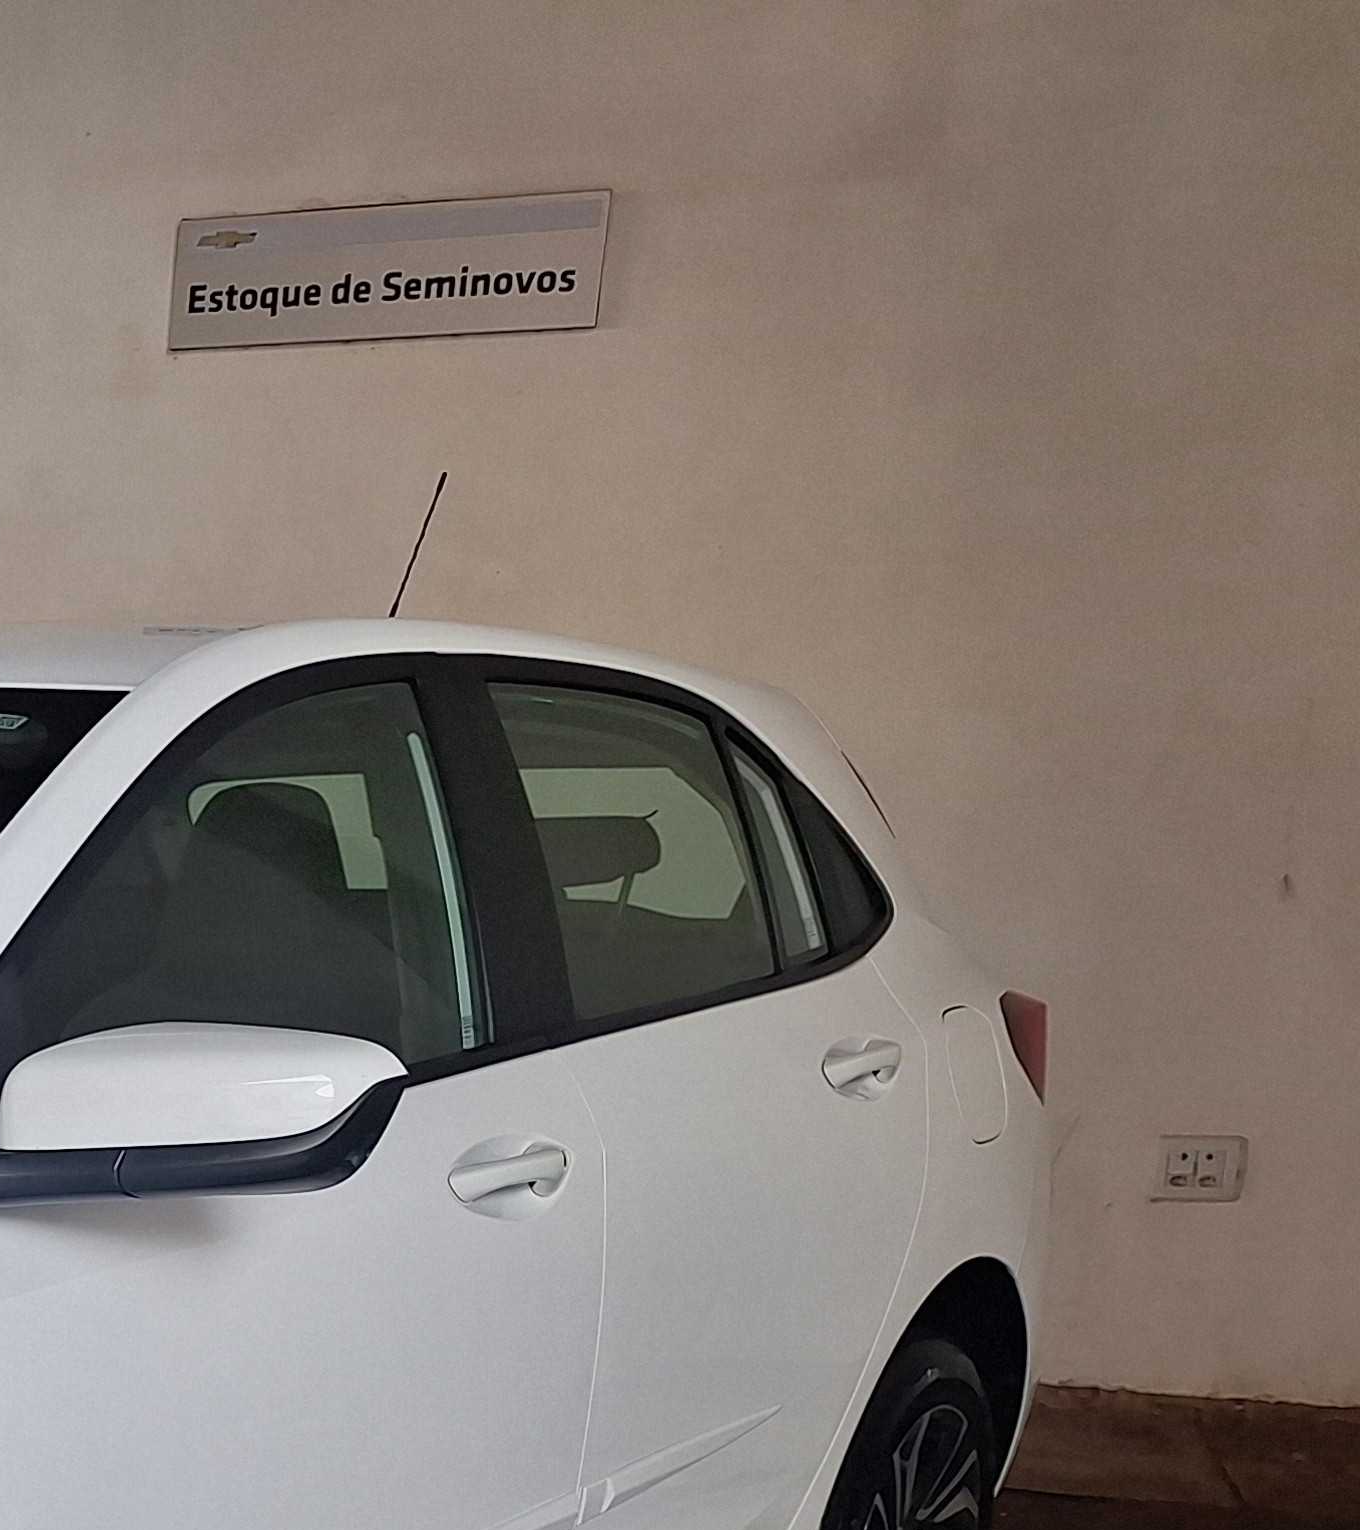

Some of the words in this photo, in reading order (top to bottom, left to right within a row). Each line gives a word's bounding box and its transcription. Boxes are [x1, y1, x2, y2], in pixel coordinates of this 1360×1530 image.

[187, 283, 322, 317] Estoque
[330, 274, 372, 305] de
[380, 266, 577, 302] Seminovos
